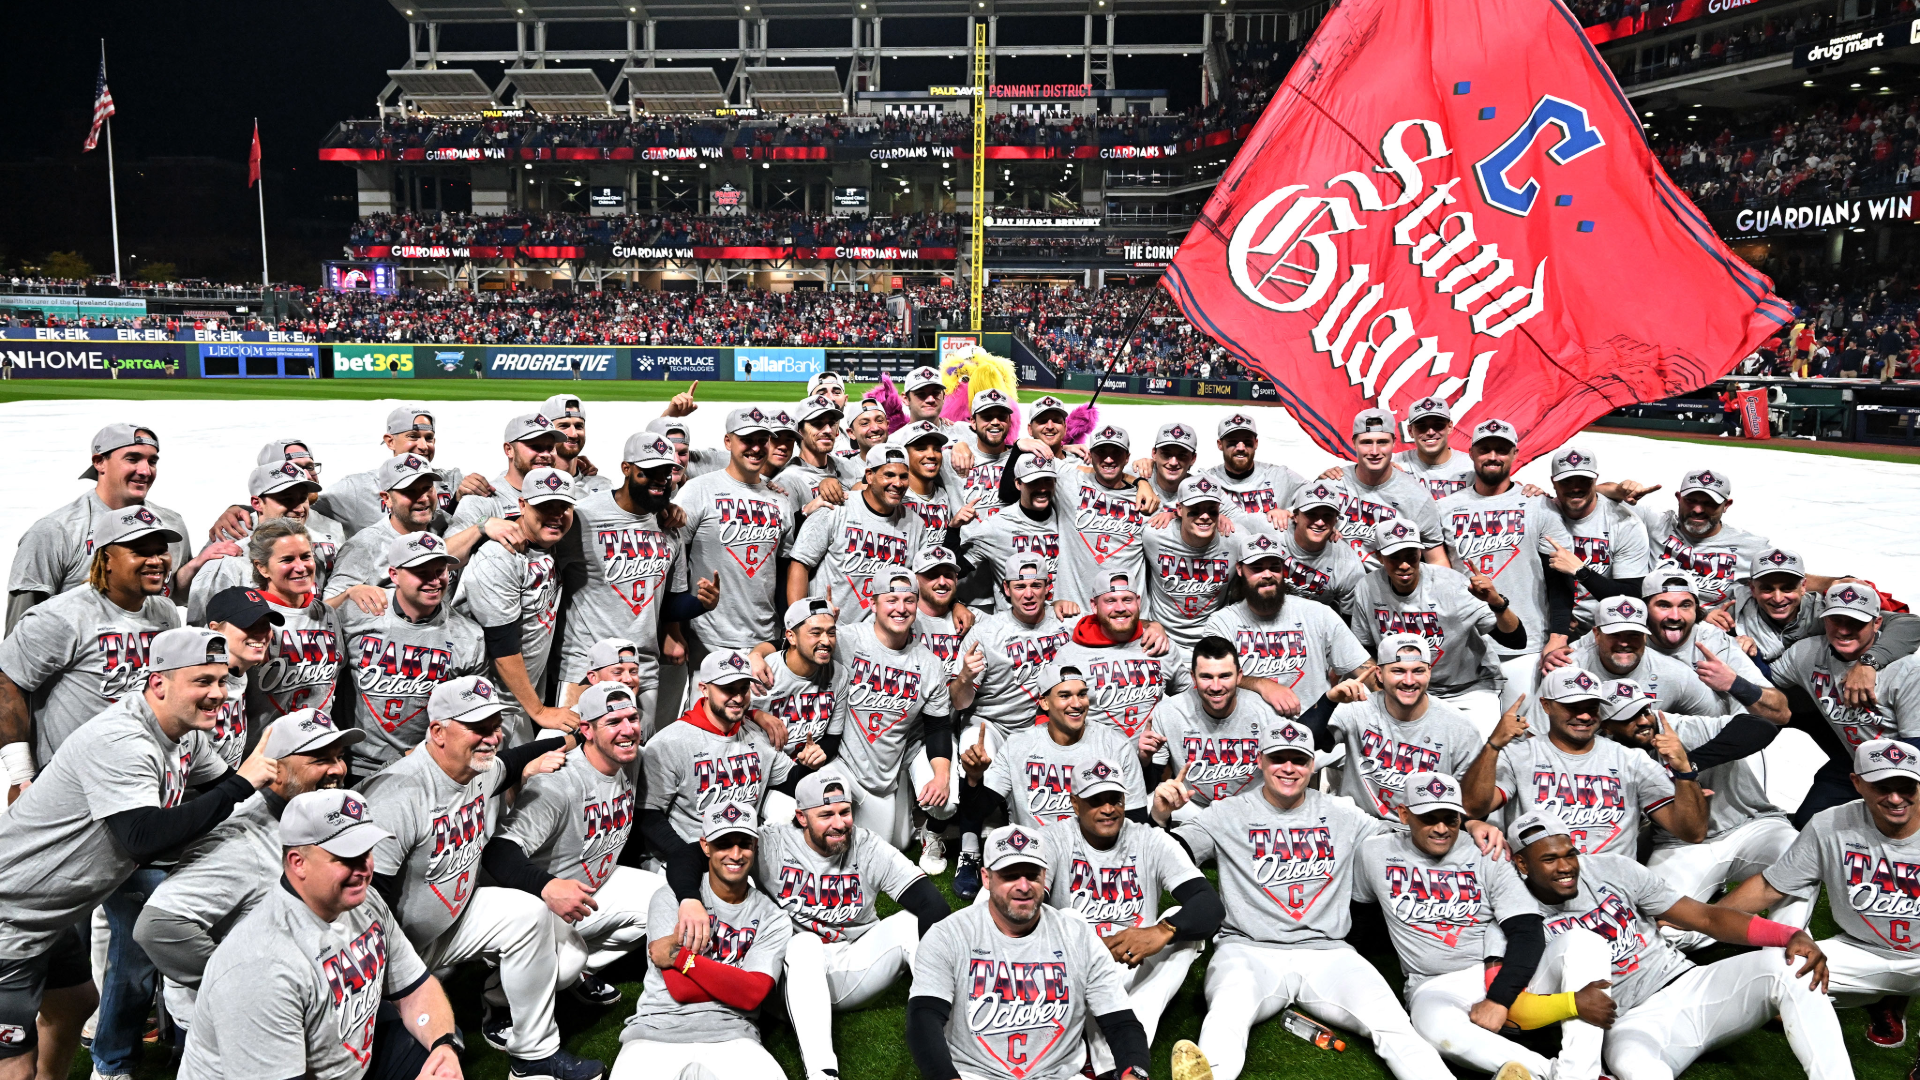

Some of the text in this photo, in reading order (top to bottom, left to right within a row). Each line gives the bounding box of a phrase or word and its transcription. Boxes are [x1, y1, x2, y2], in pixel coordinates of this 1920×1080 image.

[1808, 32, 1884, 61] drug mart
[1830, 32, 1863, 46] DISCOUNT
[989, 83, 1093, 98] PENNANT DISTRICT
[426, 147, 505, 161] GUARDIANS WIN
[641, 146, 723, 161] GUARDIANS WIN
[870, 145, 954, 160] GUARDIANS WIN
[1100, 143, 1177, 159] GUARDIANS WIN
[1475, 95, 1605, 218] C
[715, 190, 741, 198] FAMILY
[718, 197, 738, 205] DECK
[997, 217, 1016, 227] FAT
[1056, 217, 1101, 227] BREWERY
[1325, 118, 1548, 338] Stand
[1736, 195, 1913, 233] GUARDIANS WIN
[391, 245, 470, 259] GUARDIANS WIN
[612, 245, 694, 259] GUARDIANS WIN
[834, 246, 919, 260] GUARDIANS WIN
[1123, 245, 1180, 259] THE CORNE
[108, 300, 143, 308] Guardians
[657, 356, 714, 366] PARK PLACE
[1098, 378, 1127, 389] Boking.com
[1155, 379, 1166, 388] SHOP
[1205, 384, 1231, 394] BETMGM
[715, 498, 783, 525] TAKE
[1078, 485, 1144, 524] TAKE
[1338, 492, 1397, 523] TAKE
[719, 517, 783, 547] October
[1075, 506, 1145, 535] October
[1452, 509, 1525, 539] TAKE
[598, 529, 672, 561] TAKE
[745, 545, 759, 565] C
[844, 525, 908, 562] TAKE
[1096, 534, 1110, 553] C
[1456, 526, 1525, 558] October
[604, 548, 671, 584] October
[1157, 552, 1230, 584] TAKE
[1479, 554, 1495, 575] C
[1660, 534, 1737, 582] TAKE
[245, 590, 262, 603] C
[632, 580, 646, 603] C
[1162, 574, 1223, 595] October
[1184, 595, 1198, 613] C
[1374, 608, 1444, 637] TAKE
[358, 635, 452, 682] TAKE
[1006, 630, 1071, 671] TAKE
[1236, 629, 1308, 660] TAKE
[1089, 658, 1163, 691] TAKE
[1239, 648, 1308, 678] October
[851, 655, 922, 701] TAKE
[383, 698, 403, 721] C
[848, 680, 917, 713] October
[1095, 680, 1165, 712] October
[868, 712, 883, 733] C
[1123, 704, 1139, 725] C
[1820, 697, 1883, 726] October
[1182, 737, 1260, 766] TAKE
[1361, 728, 1441, 773] TAKE
[1889, 748, 1900, 760] C
[694, 751, 763, 795] TAKE
[1185, 757, 1258, 786] October
[697, 770, 761, 811] October
[1213, 782, 1228, 801] C
[1532, 770, 1625, 809] TAKE
[327, 800, 359, 821] 20 C
[583, 788, 635, 842] TAKE
[1534, 794, 1623, 826] October
[432, 792, 486, 859] TAKE
[1013, 834, 1023, 846] C
[1248, 826, 1336, 864] TAKE
[596, 853, 614, 879] C
[1251, 842, 1336, 884] October
[1844, 851, 1920, 900] TAK
[453, 871, 470, 903] C
[779, 865, 864, 910] TAKE
[1070, 858, 1144, 903] TAKE
[1385, 864, 1482, 903] TAKE
[1069, 887, 1145, 927] October
[1288, 884, 1305, 909] C
[1391, 885, 1481, 923] October
[1848, 882, 1920, 915] Octo
[1890, 919, 1911, 943] C
[322, 919, 387, 1008] TAKE
[969, 959, 1070, 1005] TAKE
[968, 990, 1069, 1033] October
[1007, 1033, 1028, 1066] C
